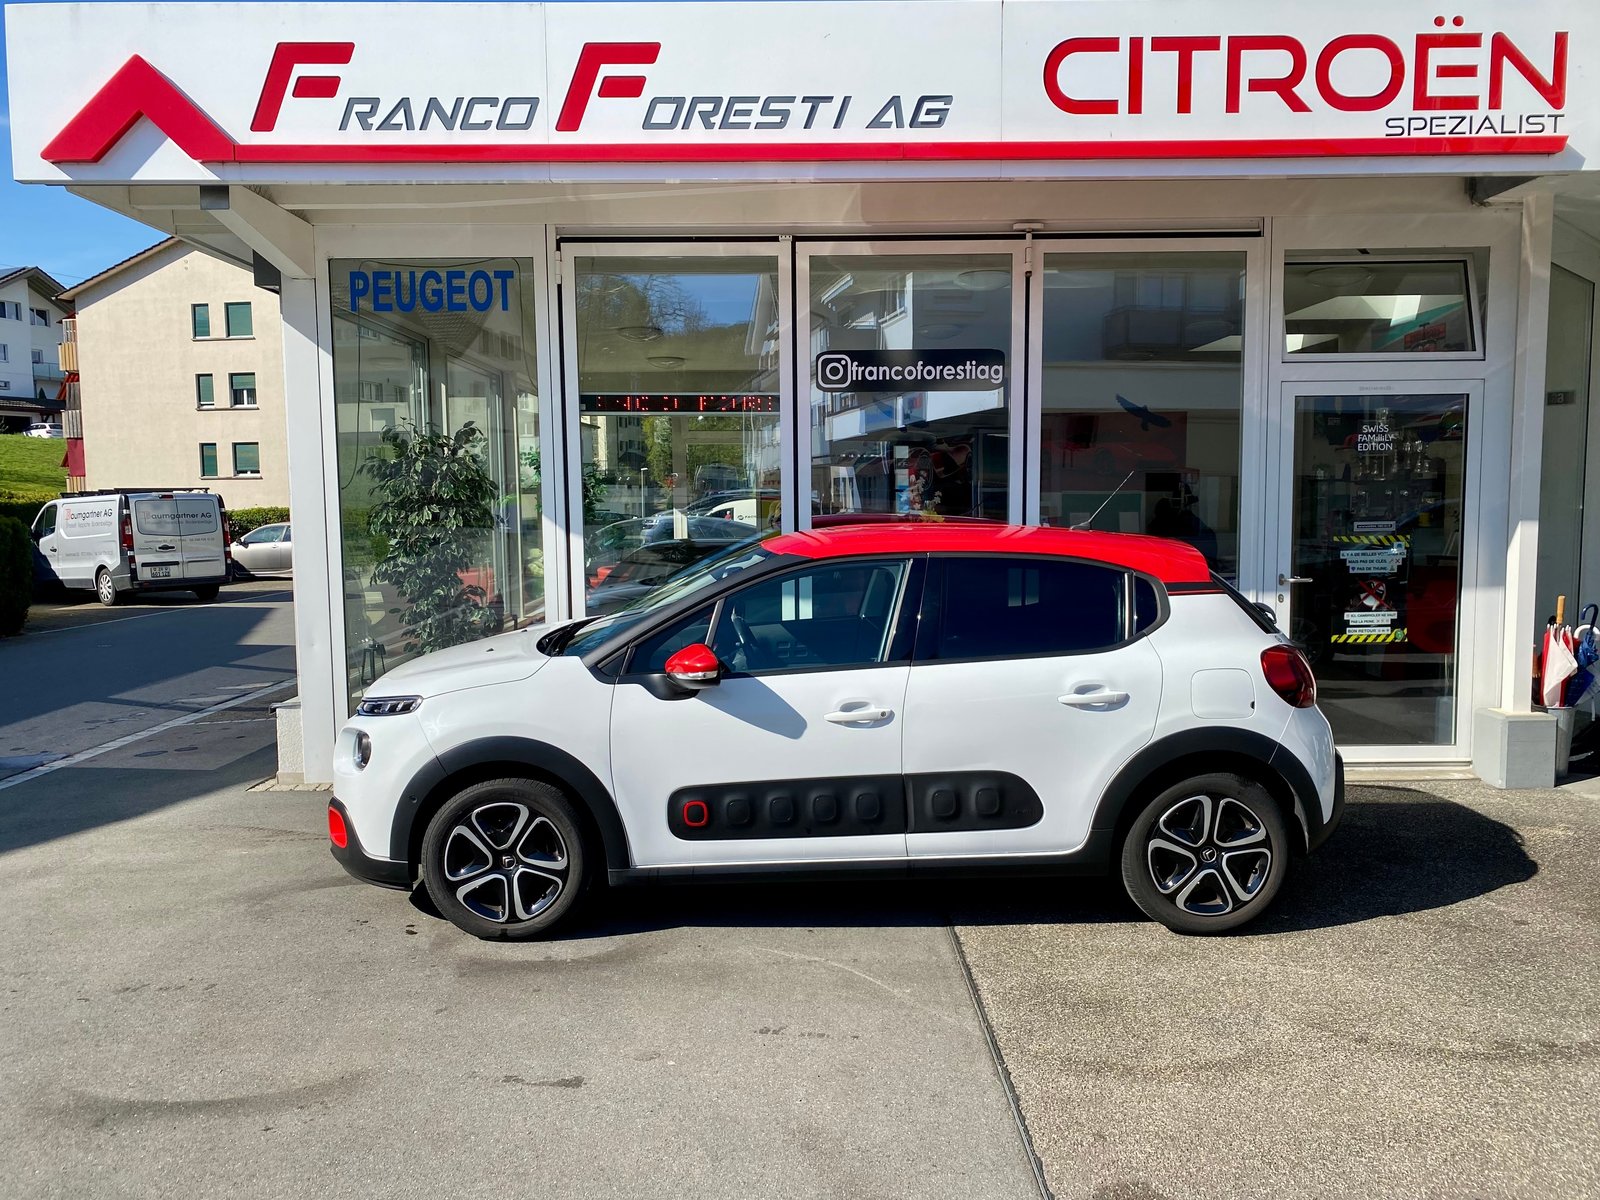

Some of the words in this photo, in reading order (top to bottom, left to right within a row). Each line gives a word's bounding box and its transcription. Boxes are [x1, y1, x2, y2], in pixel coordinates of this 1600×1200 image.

[1042, 15, 1568, 115] CITROËN
[250, 41, 540, 132] FRANCO
[555, 41, 853, 132] FORESTI
[865, 94, 953, 129] AG
[1384, 113, 1565, 137] SPEZIALIST
[349, 269, 514, 313] PEUGEOT
[852, 360, 1004, 384] francoforestiag
[1362, 424, 1389, 433] SWISS
[1357, 442, 1393, 451] EDITION
[103, 509, 113, 517] AG
